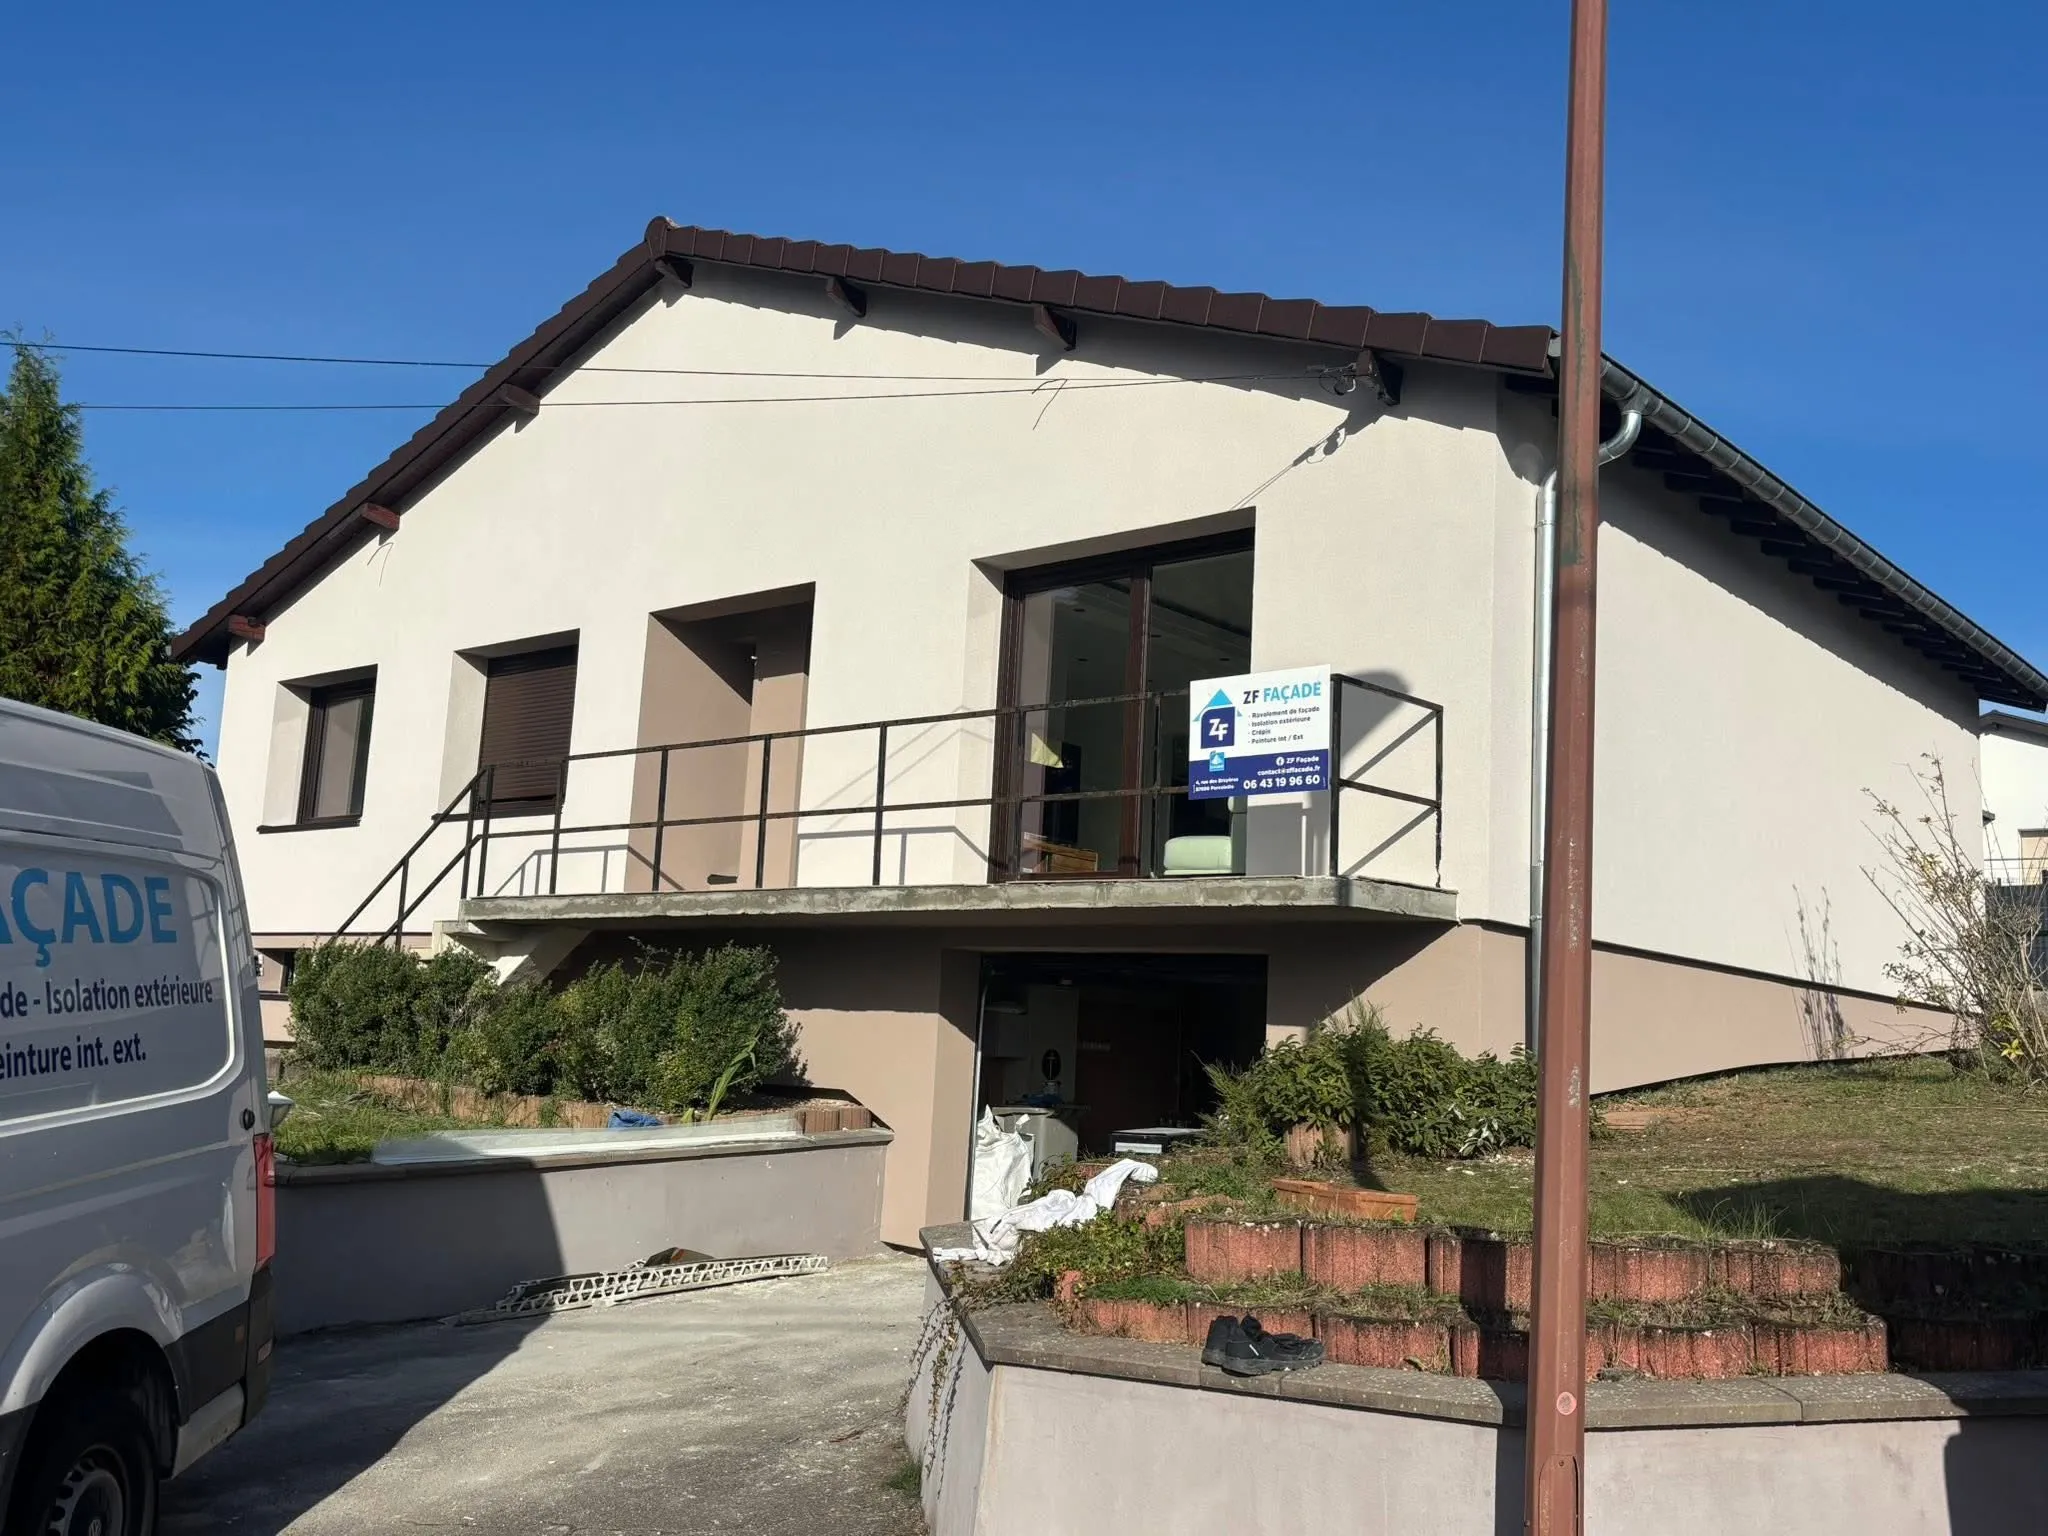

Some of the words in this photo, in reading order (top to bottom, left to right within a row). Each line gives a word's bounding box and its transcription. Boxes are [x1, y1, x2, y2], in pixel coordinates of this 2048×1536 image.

[1243, 690, 1259, 704] ZF
[1263, 682, 1321, 704] FAÇADE
[1251, 710, 1287, 718] Ravalement
[1209, 718, 1228, 741] ZF
[1296, 755, 1320, 763] Façade
[1243, 779, 1258, 790] 06
[1259, 777, 1273, 788] 43
[1275, 777, 1287, 787] 19
[1289, 775, 1303, 786] 96
[1305, 774, 1320, 784] 60
[46, 978, 130, 1015] Isolation
[134, 975, 213, 1006] extérieure
[77, 1035, 109, 1069] int.
[113, 1032, 146, 1064] ext.
